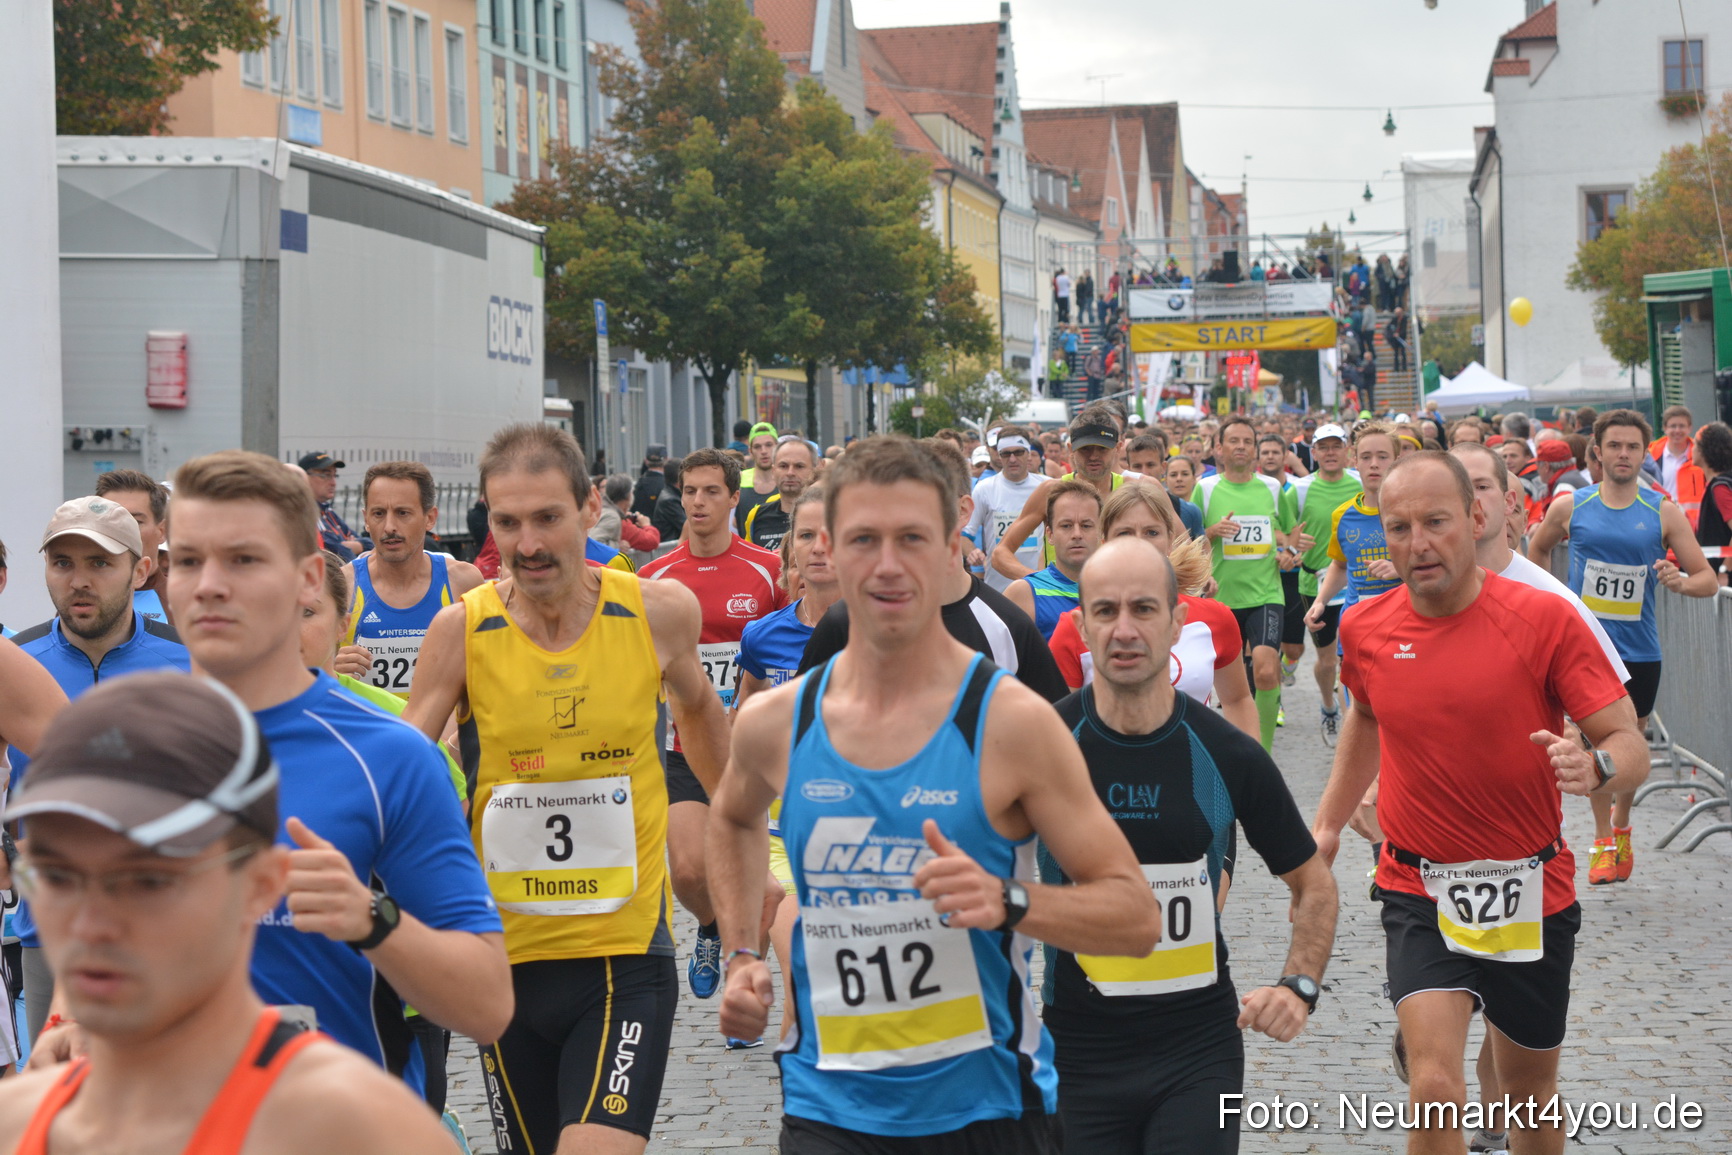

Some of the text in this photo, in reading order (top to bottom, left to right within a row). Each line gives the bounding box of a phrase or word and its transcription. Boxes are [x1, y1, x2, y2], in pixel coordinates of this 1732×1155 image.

[487, 295, 534, 366] BOCK
[1198, 326, 1268, 344] START
[997, 521, 1013, 537] 2
[1233, 526, 1262, 542] 273
[1241, 546, 1255, 554] Udo
[1586, 564, 1638, 577] PARTL Neumarkt
[1595, 576, 1635, 600] 619
[388, 646, 420, 654] Neuma
[372, 657, 418, 689] 32
[536, 684, 590, 698] FONDSZENTRUM
[550, 729, 589, 740] NEUMARKT
[508, 746, 543, 757] Schreinerei
[510, 755, 545, 772] Seidl
[516, 772, 540, 780] Berngau
[488, 793, 606, 809] PARTL Neumarkt
[918, 790, 958, 805] asics
[545, 814, 573, 862] 3
[825, 846, 938, 873] NAGE
[1423, 863, 1524, 880] PARTL Neumarkt
[522, 877, 598, 896] Thomas
[1147, 877, 1195, 889] umarkt
[809, 889, 850, 908] TSG
[1448, 877, 1523, 924] 626
[1156, 895, 1192, 943] 0
[805, 918, 932, 939] PARTL Neumarkt
[835, 941, 942, 1007] 612
